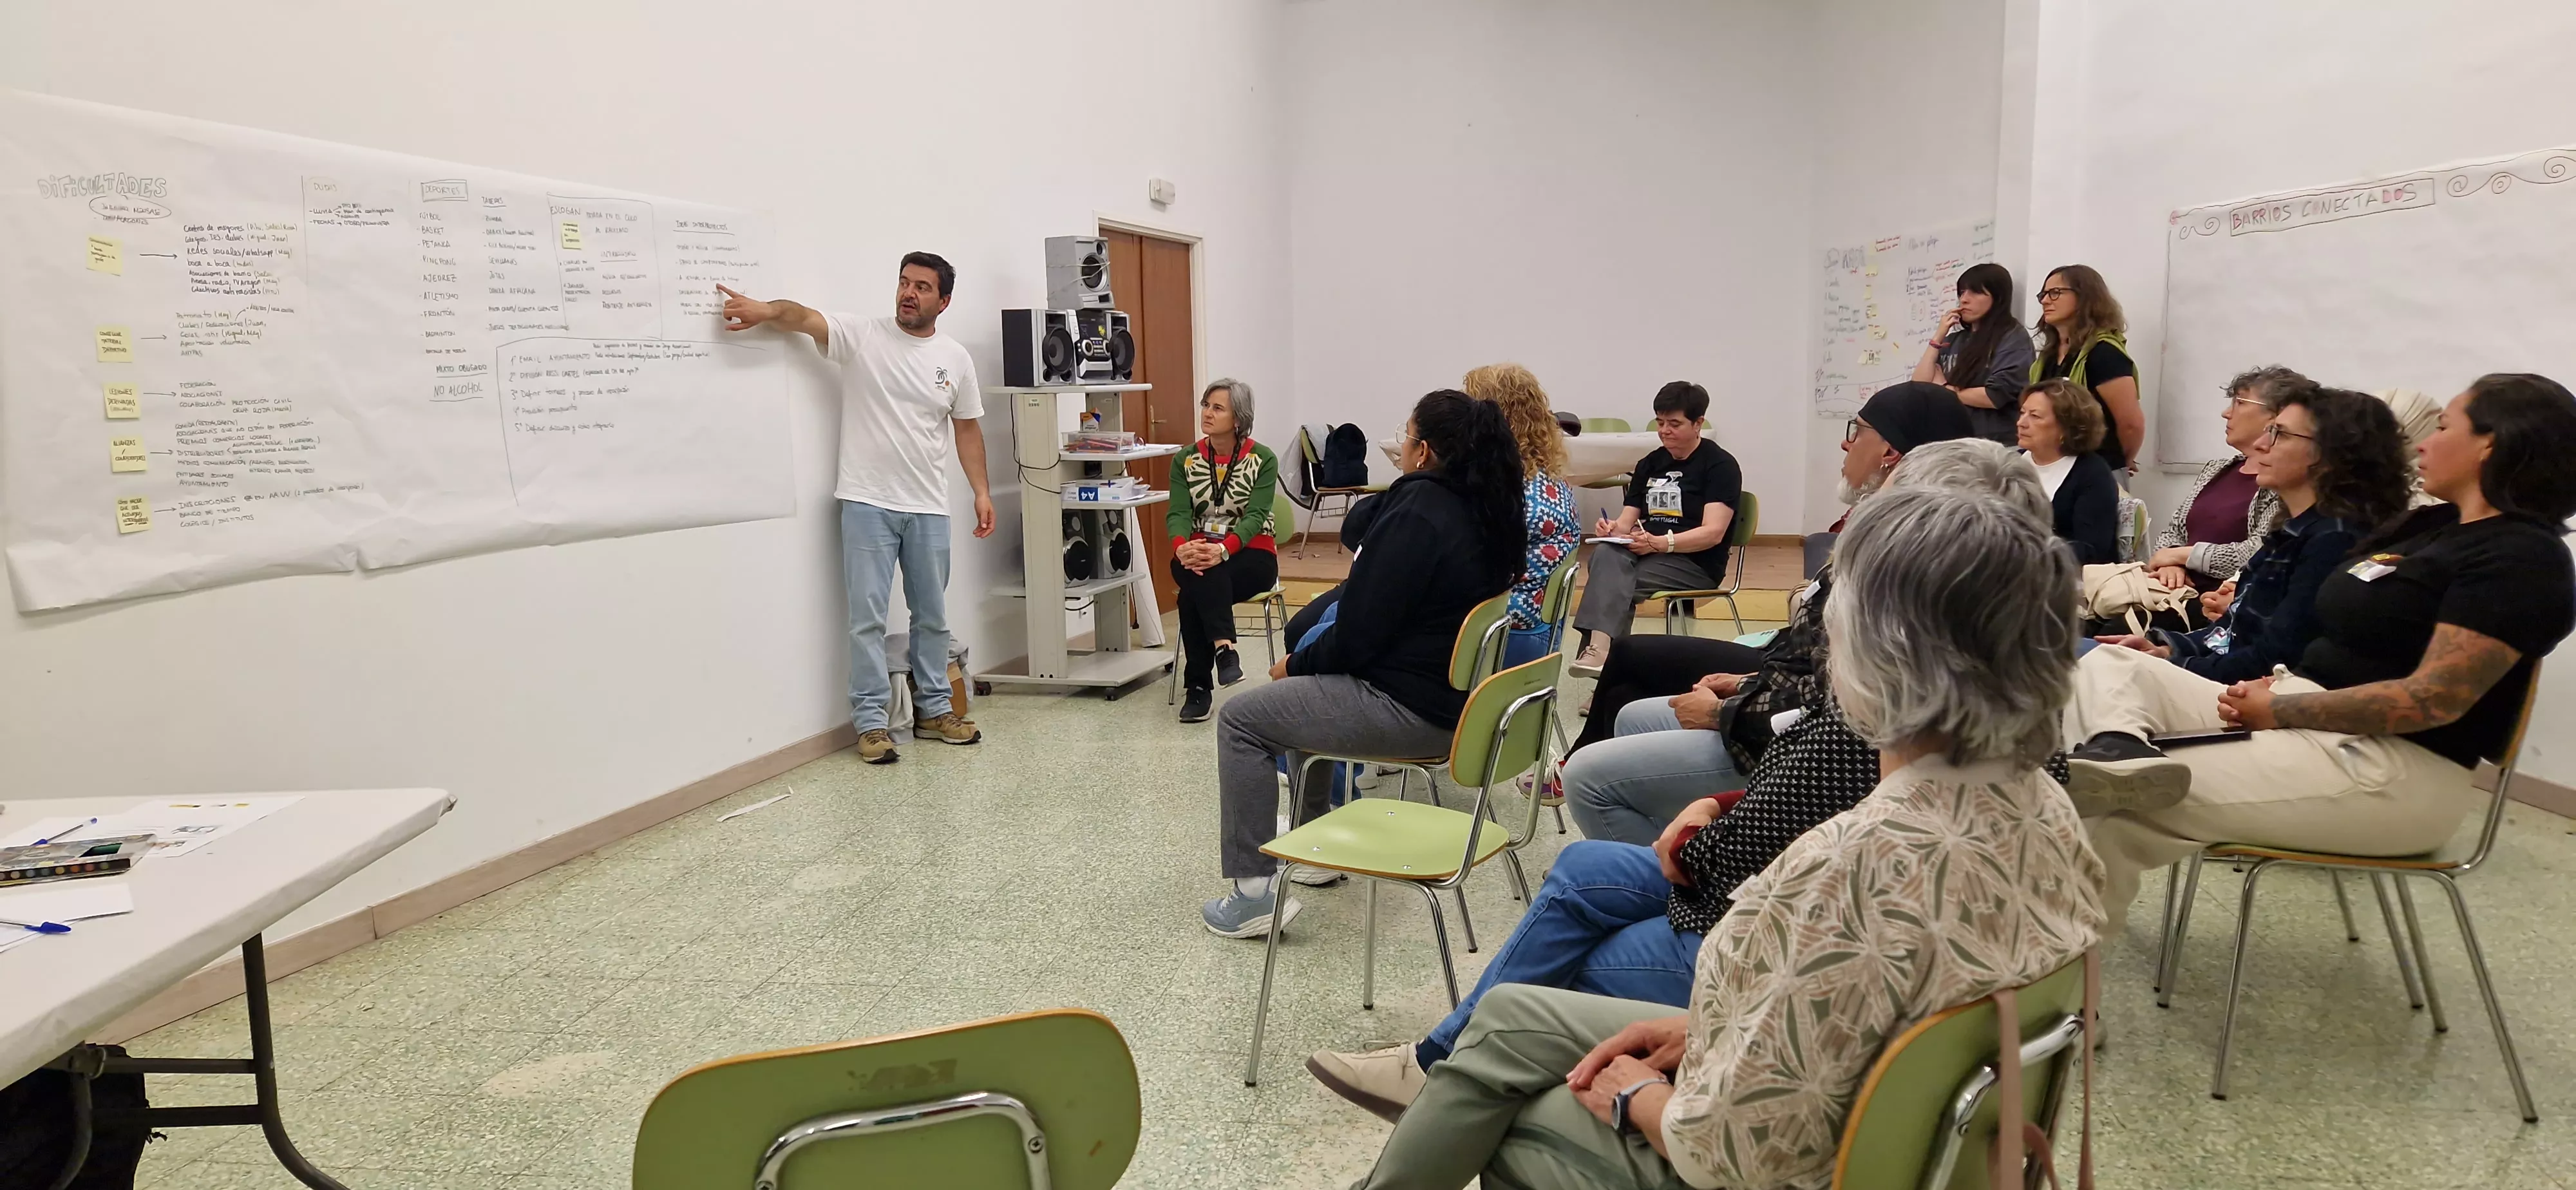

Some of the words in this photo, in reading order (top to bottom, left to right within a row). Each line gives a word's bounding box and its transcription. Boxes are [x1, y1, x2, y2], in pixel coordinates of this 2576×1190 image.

[424, 185, 460, 195] DEPORTES
[550, 206, 581, 216] ESLOGAN
[2233, 203, 2292, 229] BARRIOS
[2302, 183, 2417, 218] CONECTADOS
[421, 225, 444, 236] BASKET
[423, 274, 457, 283] AJEDREZ
[423, 292, 459, 301] ATLETISMO
[434, 385, 444, 397] NO
[449, 382, 484, 397] ALCOHOL
[1081, 491, 1095, 500] A4
